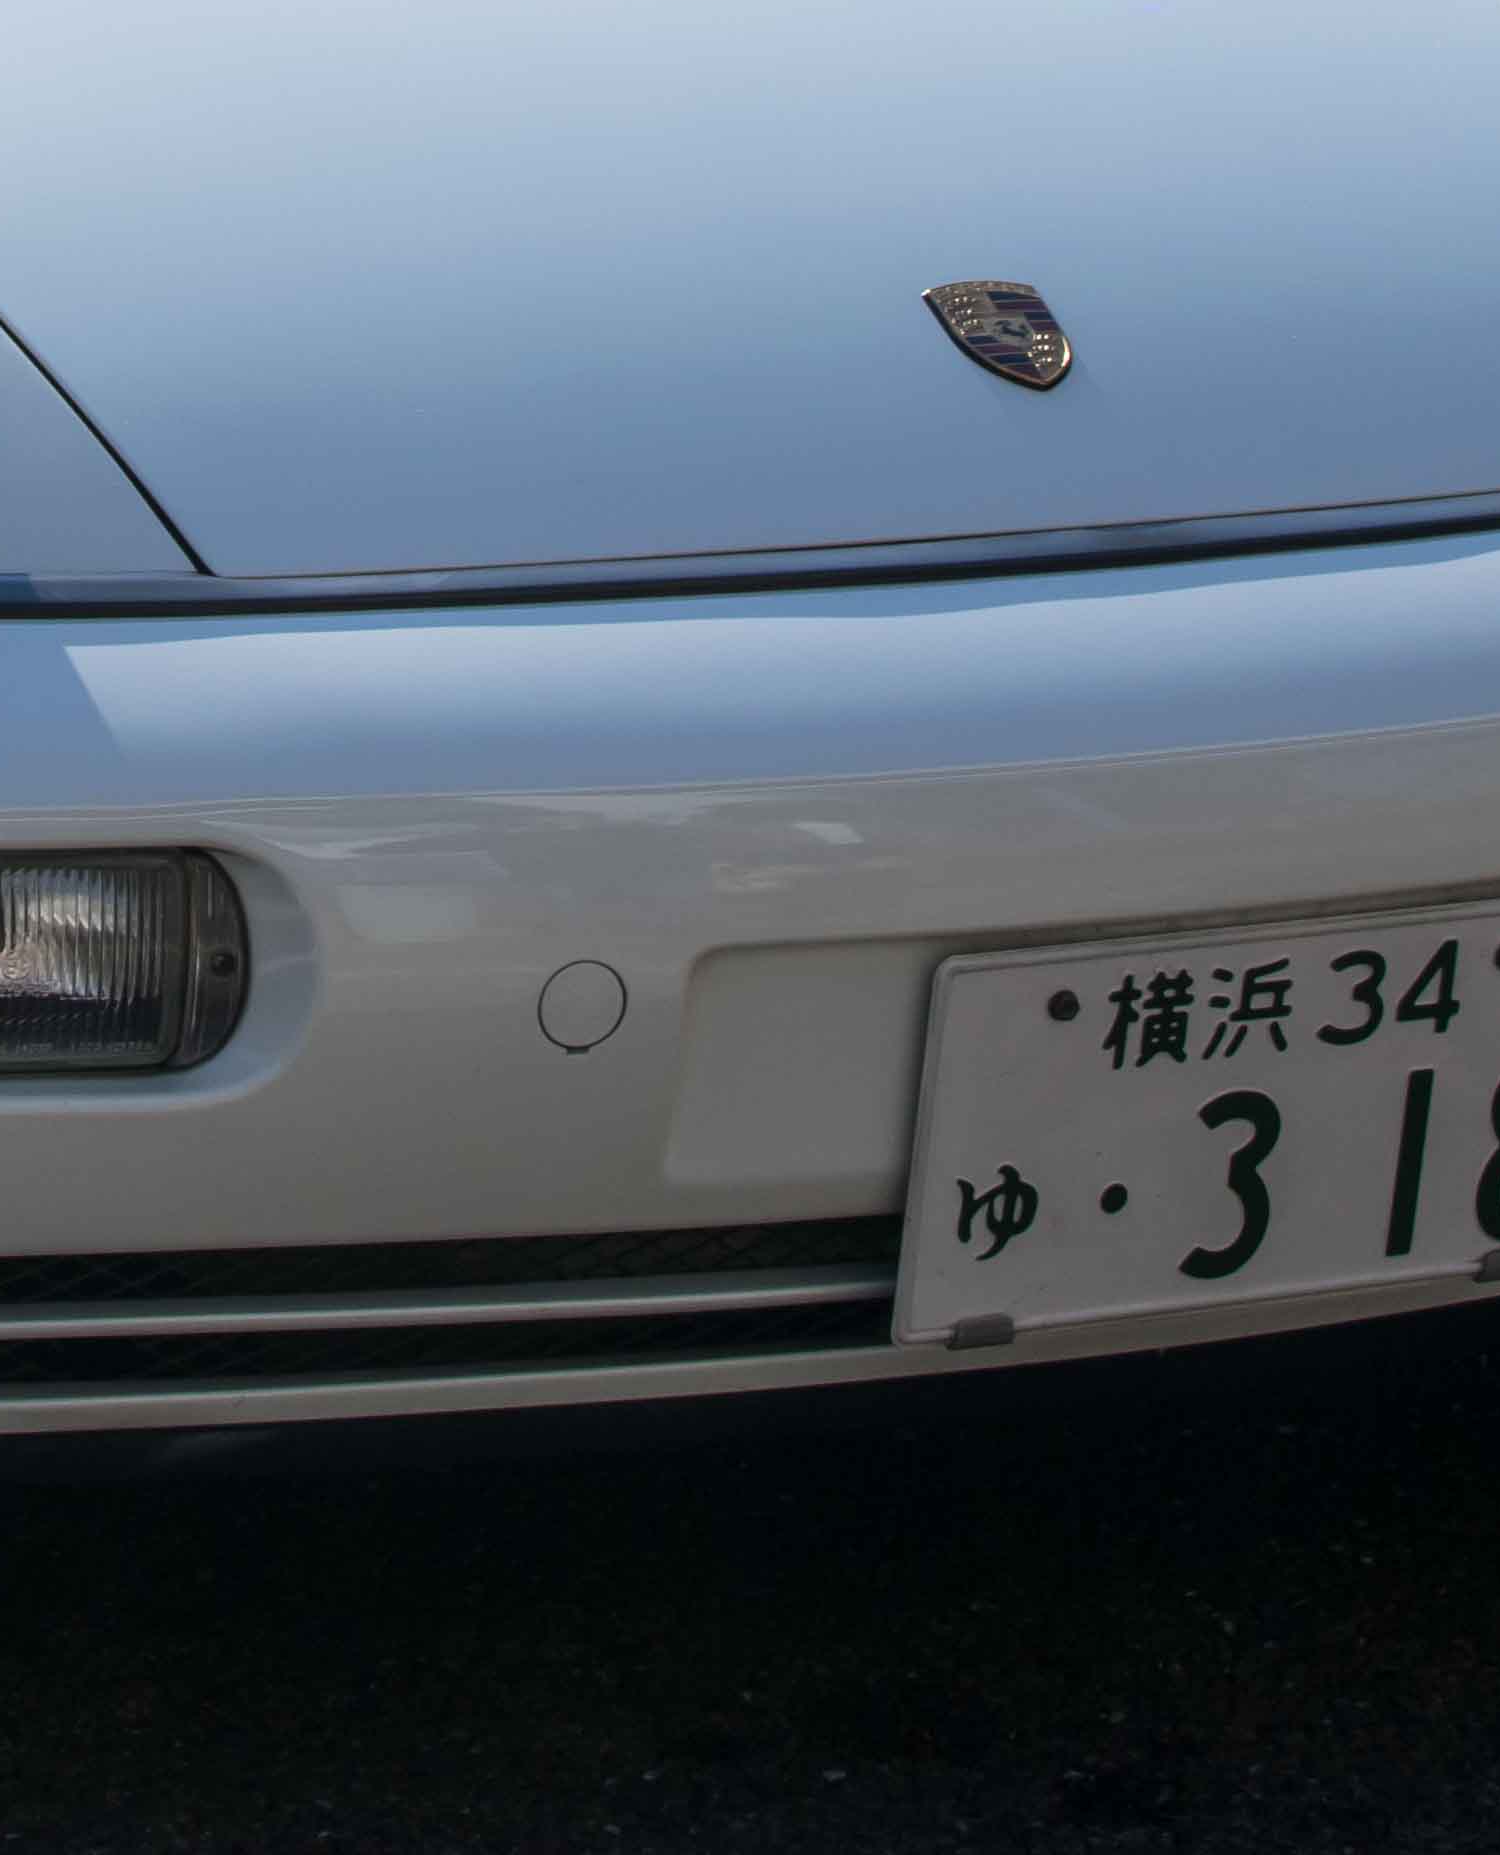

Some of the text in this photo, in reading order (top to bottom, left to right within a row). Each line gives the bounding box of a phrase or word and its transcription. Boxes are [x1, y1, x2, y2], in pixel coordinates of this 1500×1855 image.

[1102, 938, 1462, 1070] 横浜 34
[955, 1164, 1039, 1261] ゆ
